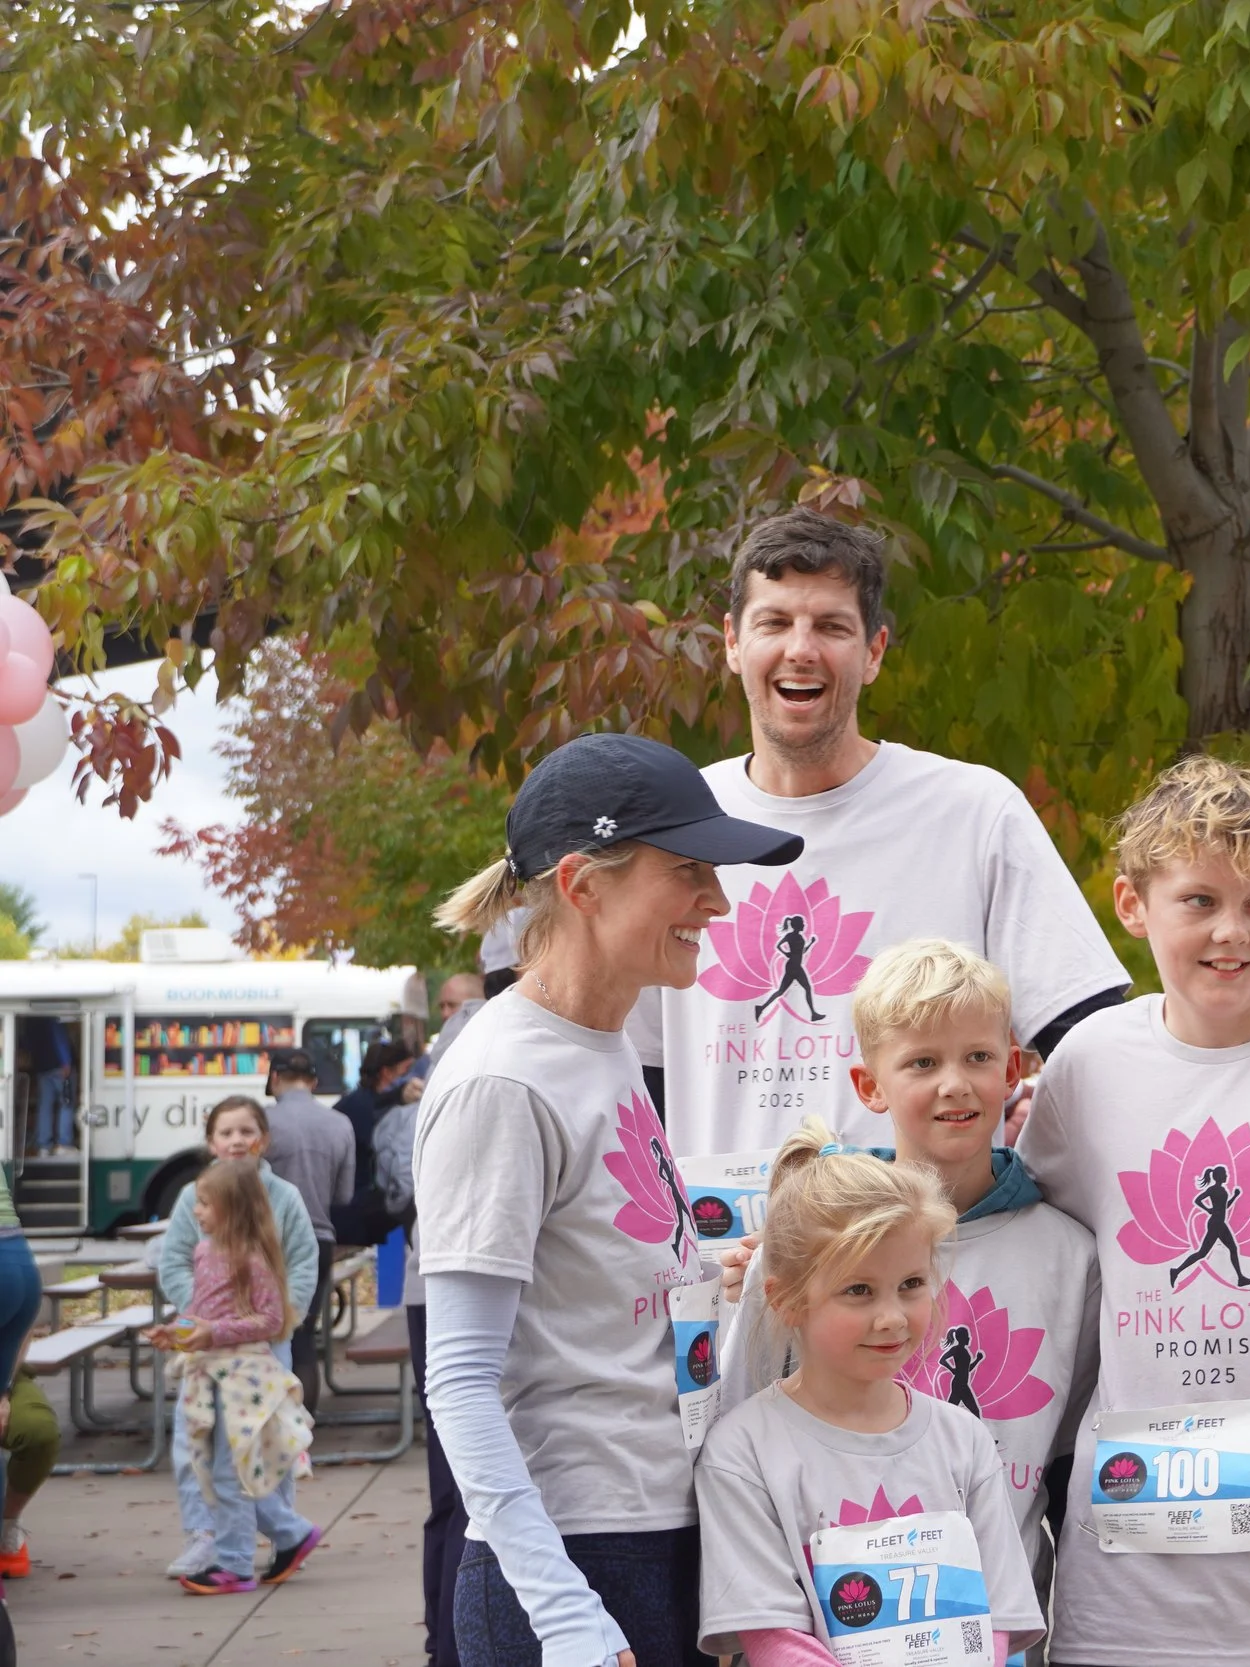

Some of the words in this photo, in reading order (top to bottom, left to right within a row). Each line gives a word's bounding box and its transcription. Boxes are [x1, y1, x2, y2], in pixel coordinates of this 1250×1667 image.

[166, 988, 282, 1000] BOOKMOBILE
[718, 1023, 747, 1035] THE
[705, 1037, 766, 1065] PINK
[778, 1034, 855, 1060] LOTU
[737, 1065, 831, 1084] PROMISE
[759, 1092, 805, 1108] 2025
[88, 1103, 150, 1137] ary
[725, 1166, 756, 1176] FLEET
[734, 1191, 768, 1234] 10
[654, 1266, 679, 1285] THE
[1136, 1289, 1162, 1304] THE
[634, 1288, 670, 1326] PI
[1117, 1305, 1186, 1337] PINK
[1182, 1367, 1236, 1386] 2025
[1148, 1420, 1182, 1432] FLEET
[1197, 1417, 1226, 1429] FEET
[1152, 1448, 1220, 1498] 100
[1168, 1510, 1193, 1518] FLEET
[866, 1534, 905, 1550] FLEET
[920, 1529, 943, 1541] FEET
[880, 1550, 917, 1561] TREASURE
[917, 1547, 939, 1555] VALLEY
[887, 1563, 939, 1622] 77
[854, 1600, 876, 1609] LOTUS
[904, 1631, 931, 1642] FLEET
[908, 1639, 930, 1649] FEET
